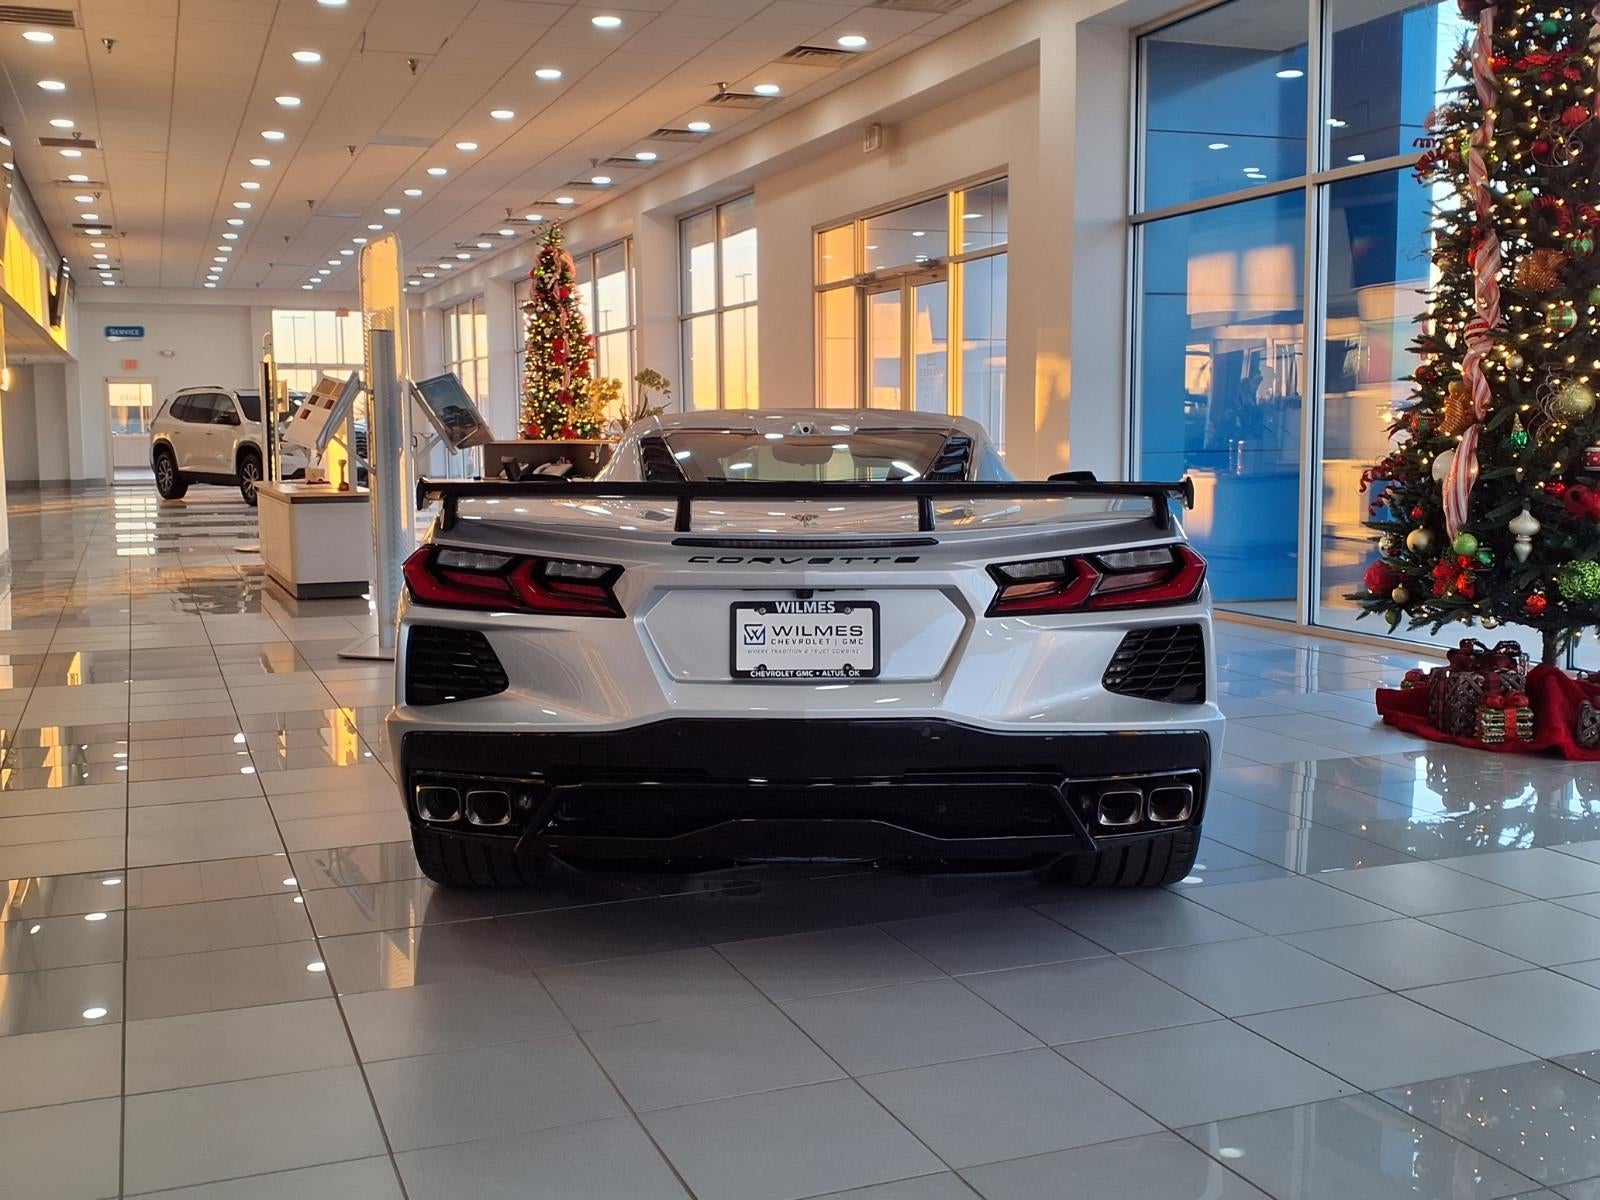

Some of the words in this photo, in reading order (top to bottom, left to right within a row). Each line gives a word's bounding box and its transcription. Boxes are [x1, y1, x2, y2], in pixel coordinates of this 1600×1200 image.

[109, 328, 139, 336] SERVICE
[687, 556, 921, 565] CORVETTE
[775, 601, 836, 613] WILMES
[771, 625, 864, 637] WILMES
[750, 670, 795, 678] CHEVROLET
[796, 670, 814, 678] GMC
[822, 670, 847, 678] ALTUS,
[848, 670, 861, 678] OK
